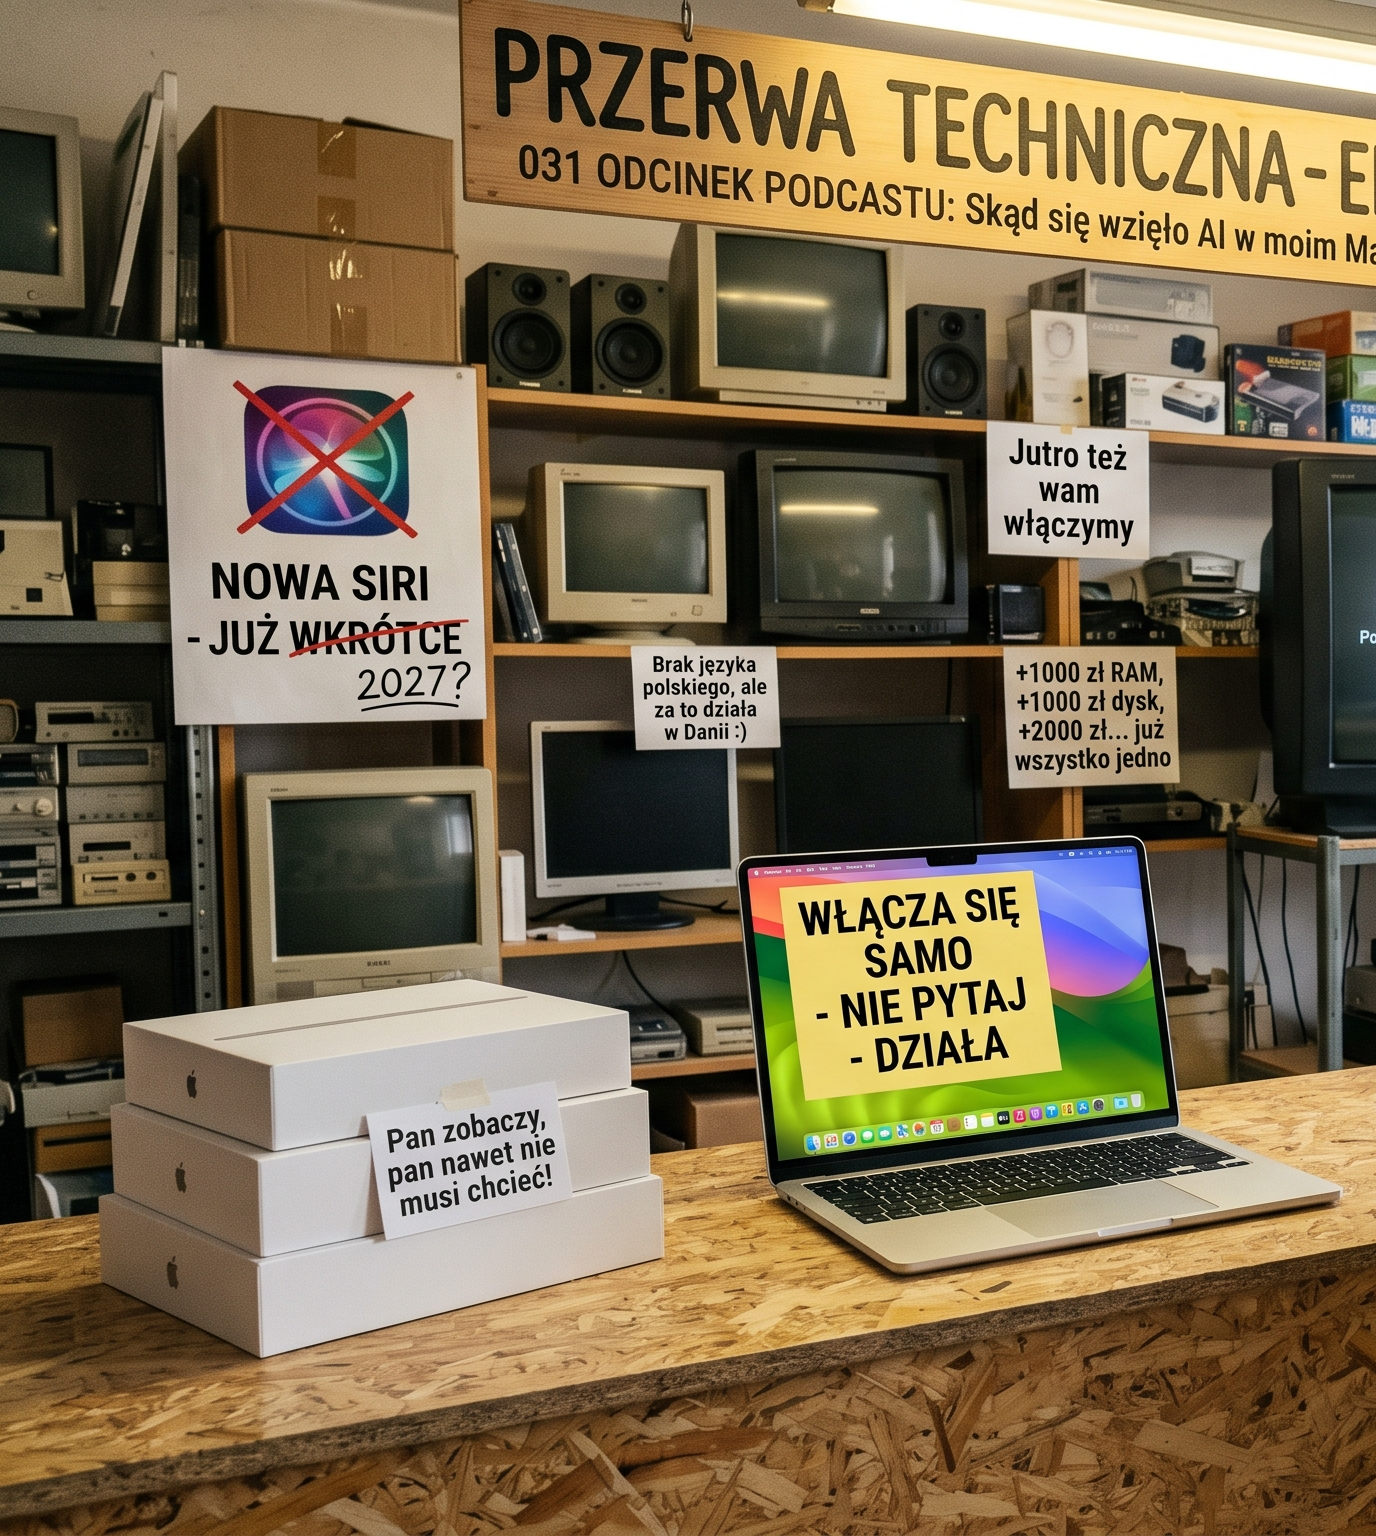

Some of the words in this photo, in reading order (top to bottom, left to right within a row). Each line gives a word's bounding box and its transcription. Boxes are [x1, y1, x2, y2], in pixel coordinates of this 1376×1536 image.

[494, 27, 855, 157] PRZERWA
[886, 79, 1296, 207] TECHNICZNA
[518, 144, 580, 185] 031
[597, 152, 754, 202] ODCINEK
[765, 170, 955, 222] PODCASTU:
[965, 192, 1038, 237] Skąd
[1048, 202, 1090, 244] się
[1098, 210, 1189, 251] wzięło
[1197, 217, 1225, 250] AI
[1234, 228, 1256, 253] w
[1264, 228, 1337, 261] moim
[1008, 438, 1079, 471] Jutro
[1086, 443, 1127, 471] też
[1038, 481, 1099, 504] wam
[1003, 507, 1134, 548] włączymy
[211, 562, 340, 601] NOWA
[352, 564, 429, 602] SIRI
[208, 612, 280, 656] JUŻ
[290, 613, 462, 656] WKRÓTCE
[357, 660, 472, 701] 2027?
[652, 654, 695, 673] Brak
[698, 655, 757, 678] języka
[1016, 661, 1080, 684] +1000
[1086, 660, 1105, 683] zł
[1111, 661, 1164, 687] RAM,
[643, 677, 735, 700] polskiego,
[740, 677, 768, 695] ale
[654, 704, 675, 719] za
[679, 702, 698, 718] to
[702, 699, 757, 718] działa
[1016, 690, 1081, 713] +1000
[1087, 689, 1106, 712] zł
[1111, 688, 1165, 717] dysk,
[664, 727, 679, 741] w
[684, 722, 729, 741] Danii
[1018, 719, 1083, 742] +2000
[1089, 717, 1129, 741] zł...
[1133, 717, 1165, 746] już
[1014, 746, 1111, 776] wszystko
[1115, 745, 1172, 775] jedno
[797, 891, 957, 940] WŁĄCZA
[964, 885, 1020, 929] SIĘ
[864, 935, 973, 979] SAMO
[840, 988, 904, 1029] NIE
[911, 976, 1027, 1021] PYTAJ
[874, 1025, 1010, 1073] DZIAŁA
[386, 1127, 436, 1154] Pan
[442, 1108, 546, 1144] zobaczy,
[387, 1160, 434, 1193] pan
[440, 1141, 515, 1176] nawet
[520, 1134, 556, 1161] nie
[399, 1181, 460, 1217] musi
[467, 1167, 553, 1203] chcieć!
